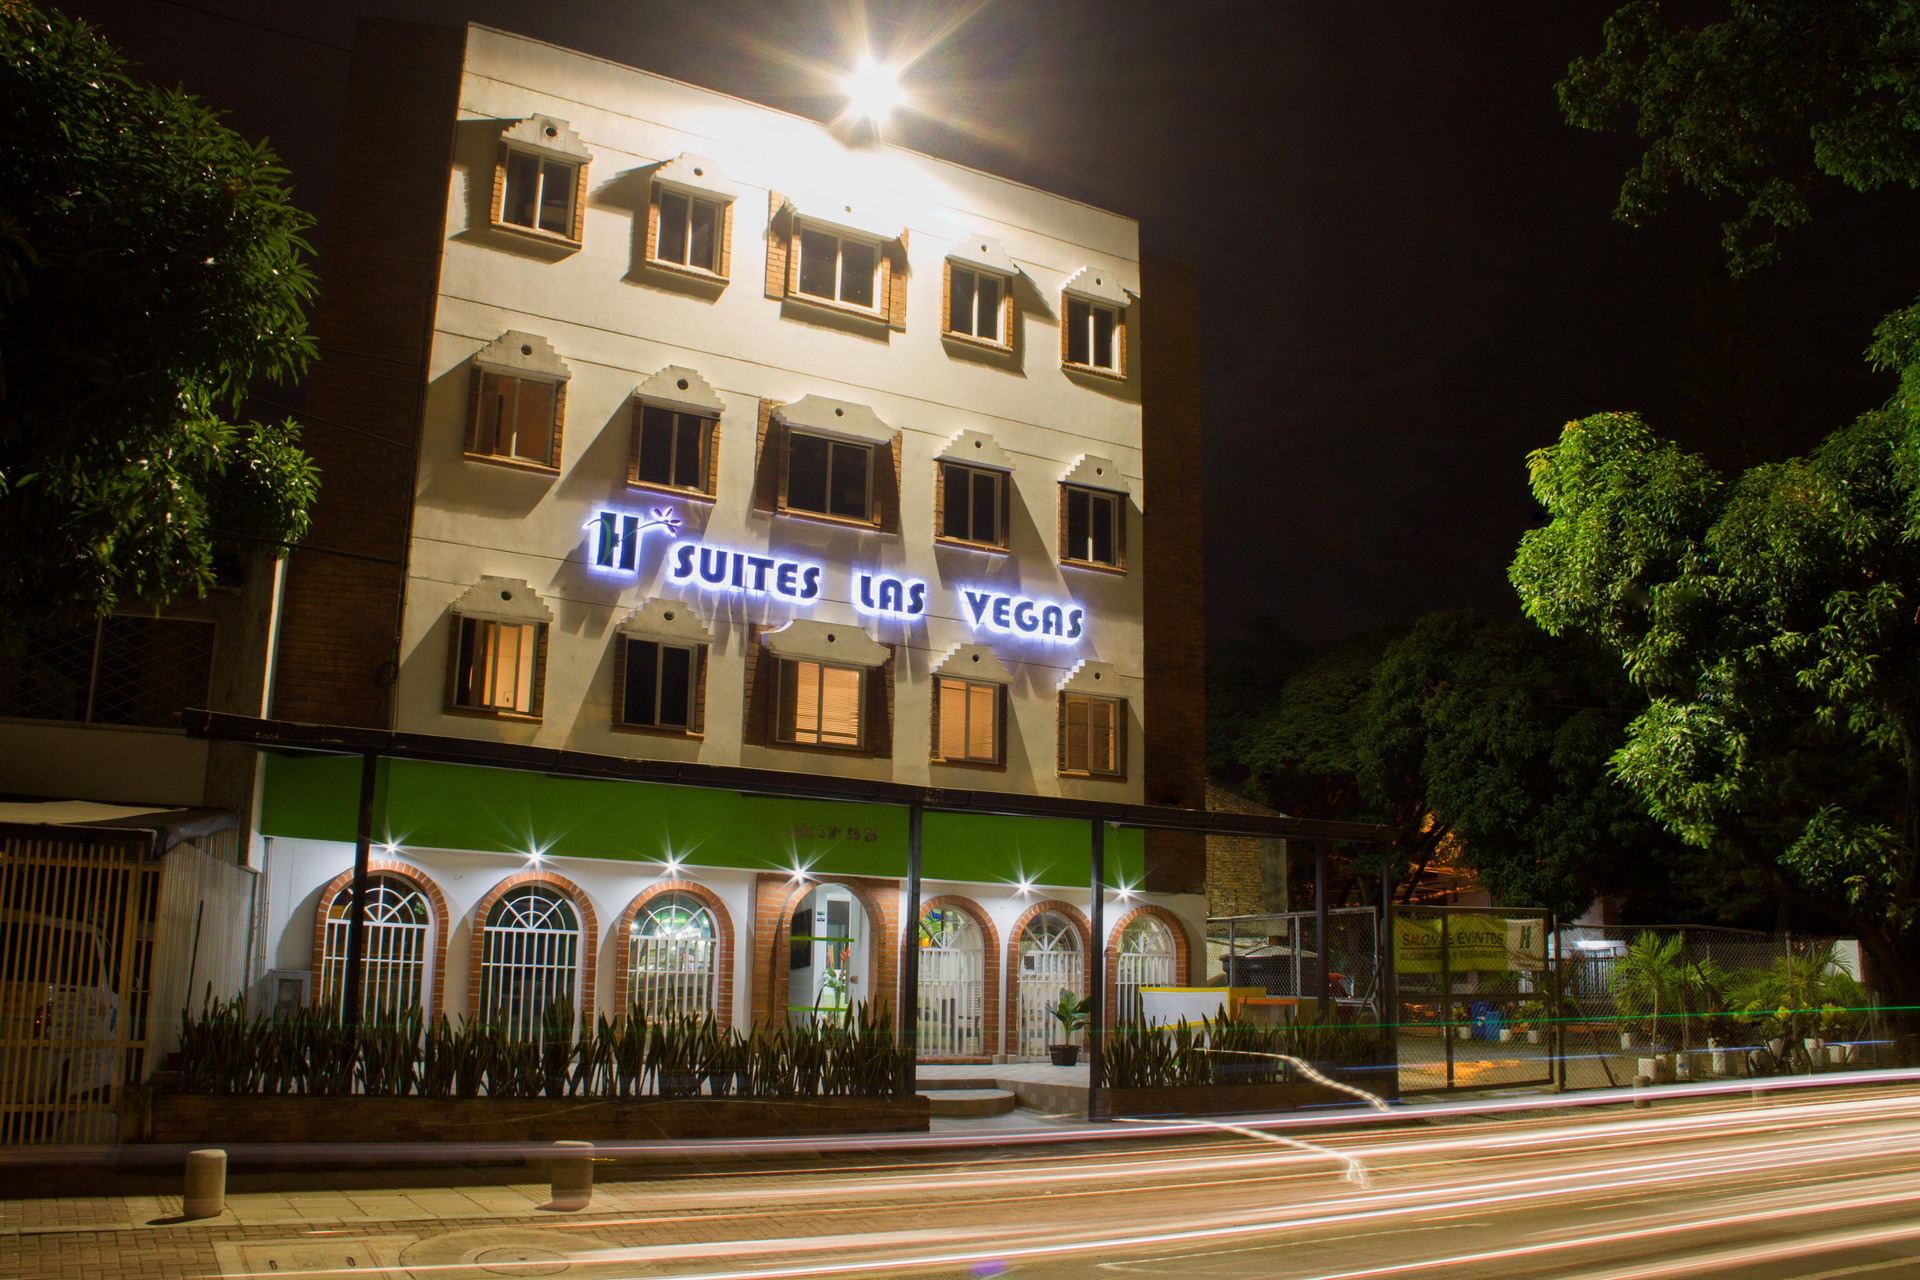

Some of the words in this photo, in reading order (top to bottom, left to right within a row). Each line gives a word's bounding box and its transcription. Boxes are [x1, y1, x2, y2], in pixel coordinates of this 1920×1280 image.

[674, 544, 820, 599] SUITES
[860, 575, 924, 615] LAS
[964, 591, 1084, 639] VEGAS
